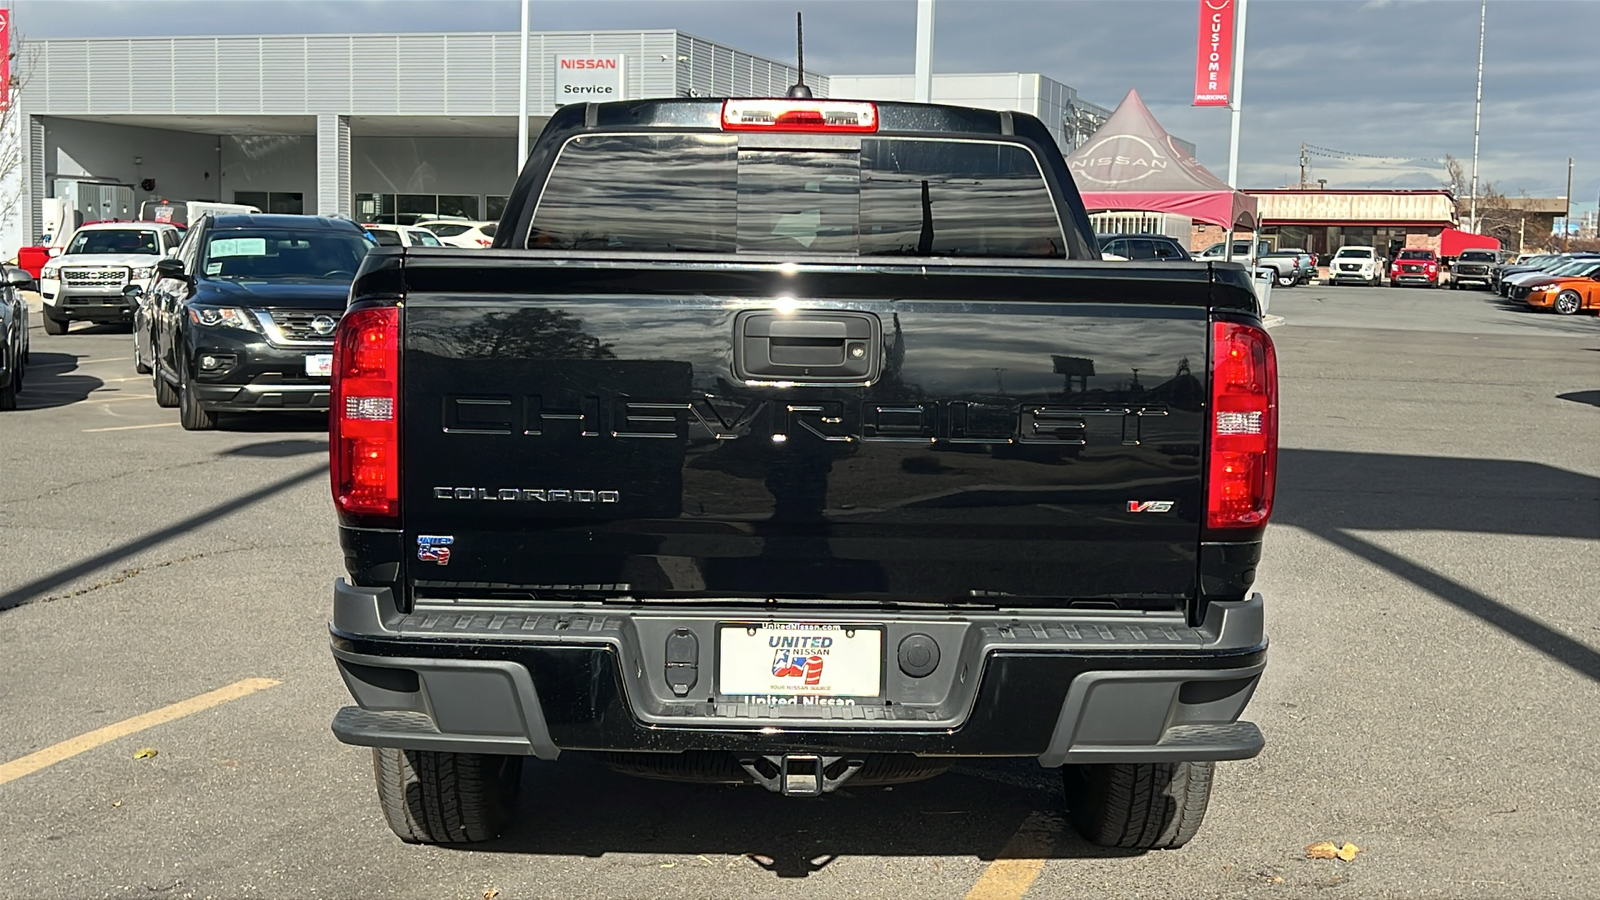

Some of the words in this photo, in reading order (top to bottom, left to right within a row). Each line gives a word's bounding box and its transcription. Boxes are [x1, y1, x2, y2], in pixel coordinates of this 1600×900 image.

[1208, 13, 1221, 91] CUSTOMER
[560, 59, 616, 69] NISSAN
[563, 84, 613, 94] Service
[1071, 155, 1168, 169] NISSAN
[442, 394, 1170, 446] CHEVROLET
[433, 486, 620, 503] COLORADO
[1126, 500, 1175, 513] V6
[762, 622, 841, 631] UnitedNissan.com
[768, 635, 833, 648] UNITED
[792, 648, 830, 656] NISSAN
